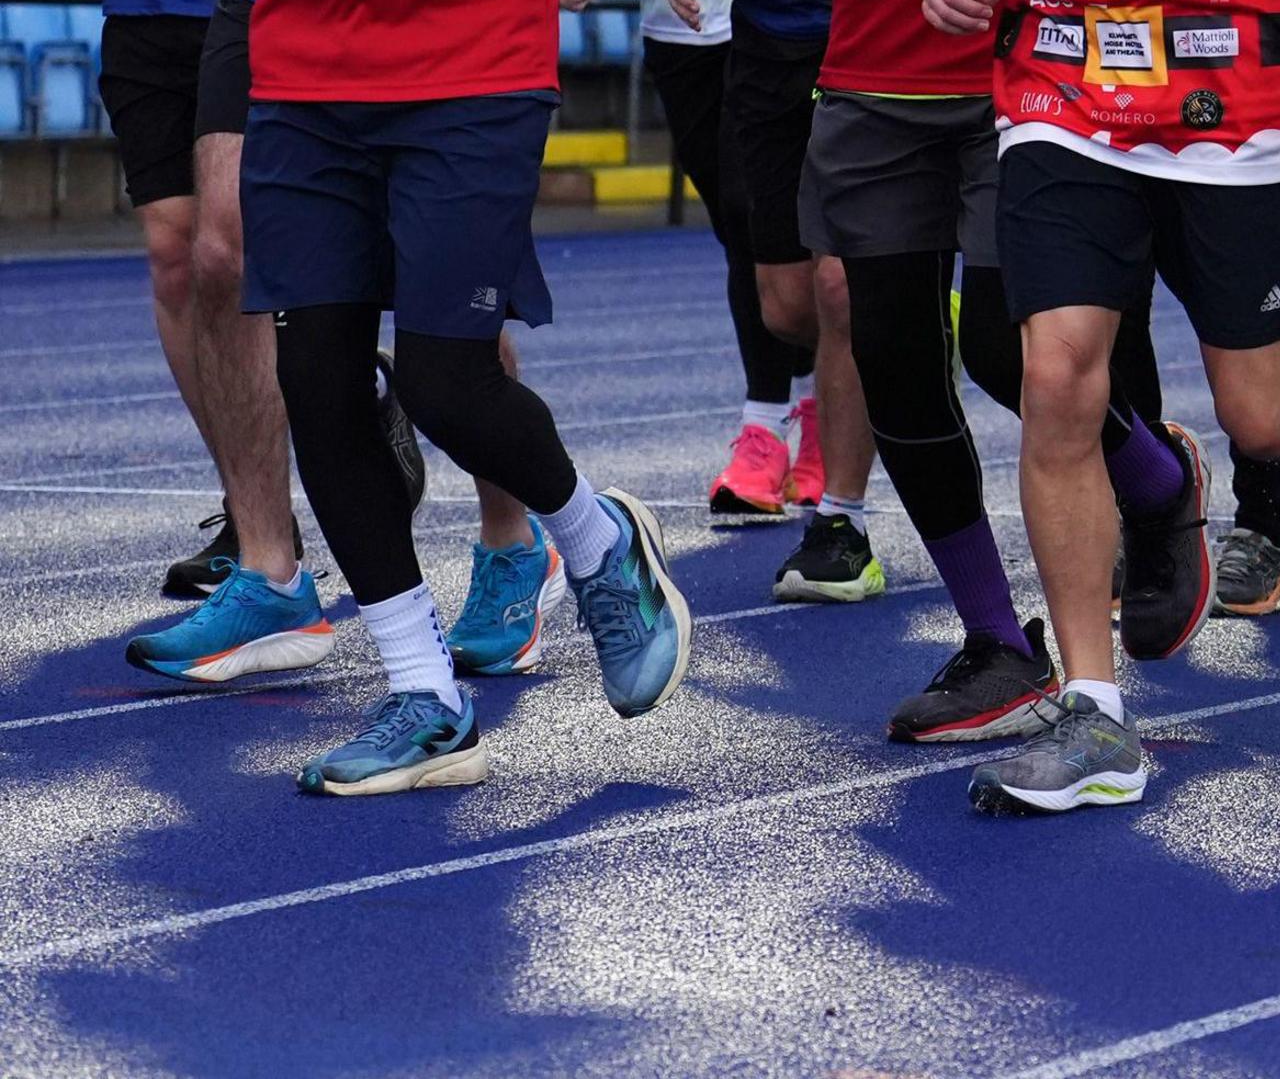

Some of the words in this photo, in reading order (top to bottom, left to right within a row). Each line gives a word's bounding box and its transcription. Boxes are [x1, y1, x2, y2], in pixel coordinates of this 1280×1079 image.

[1192, 31, 1234, 43] Mattioli
[1192, 42, 1229, 54] Woods
[1091, 109, 1155, 125] ROMERO
